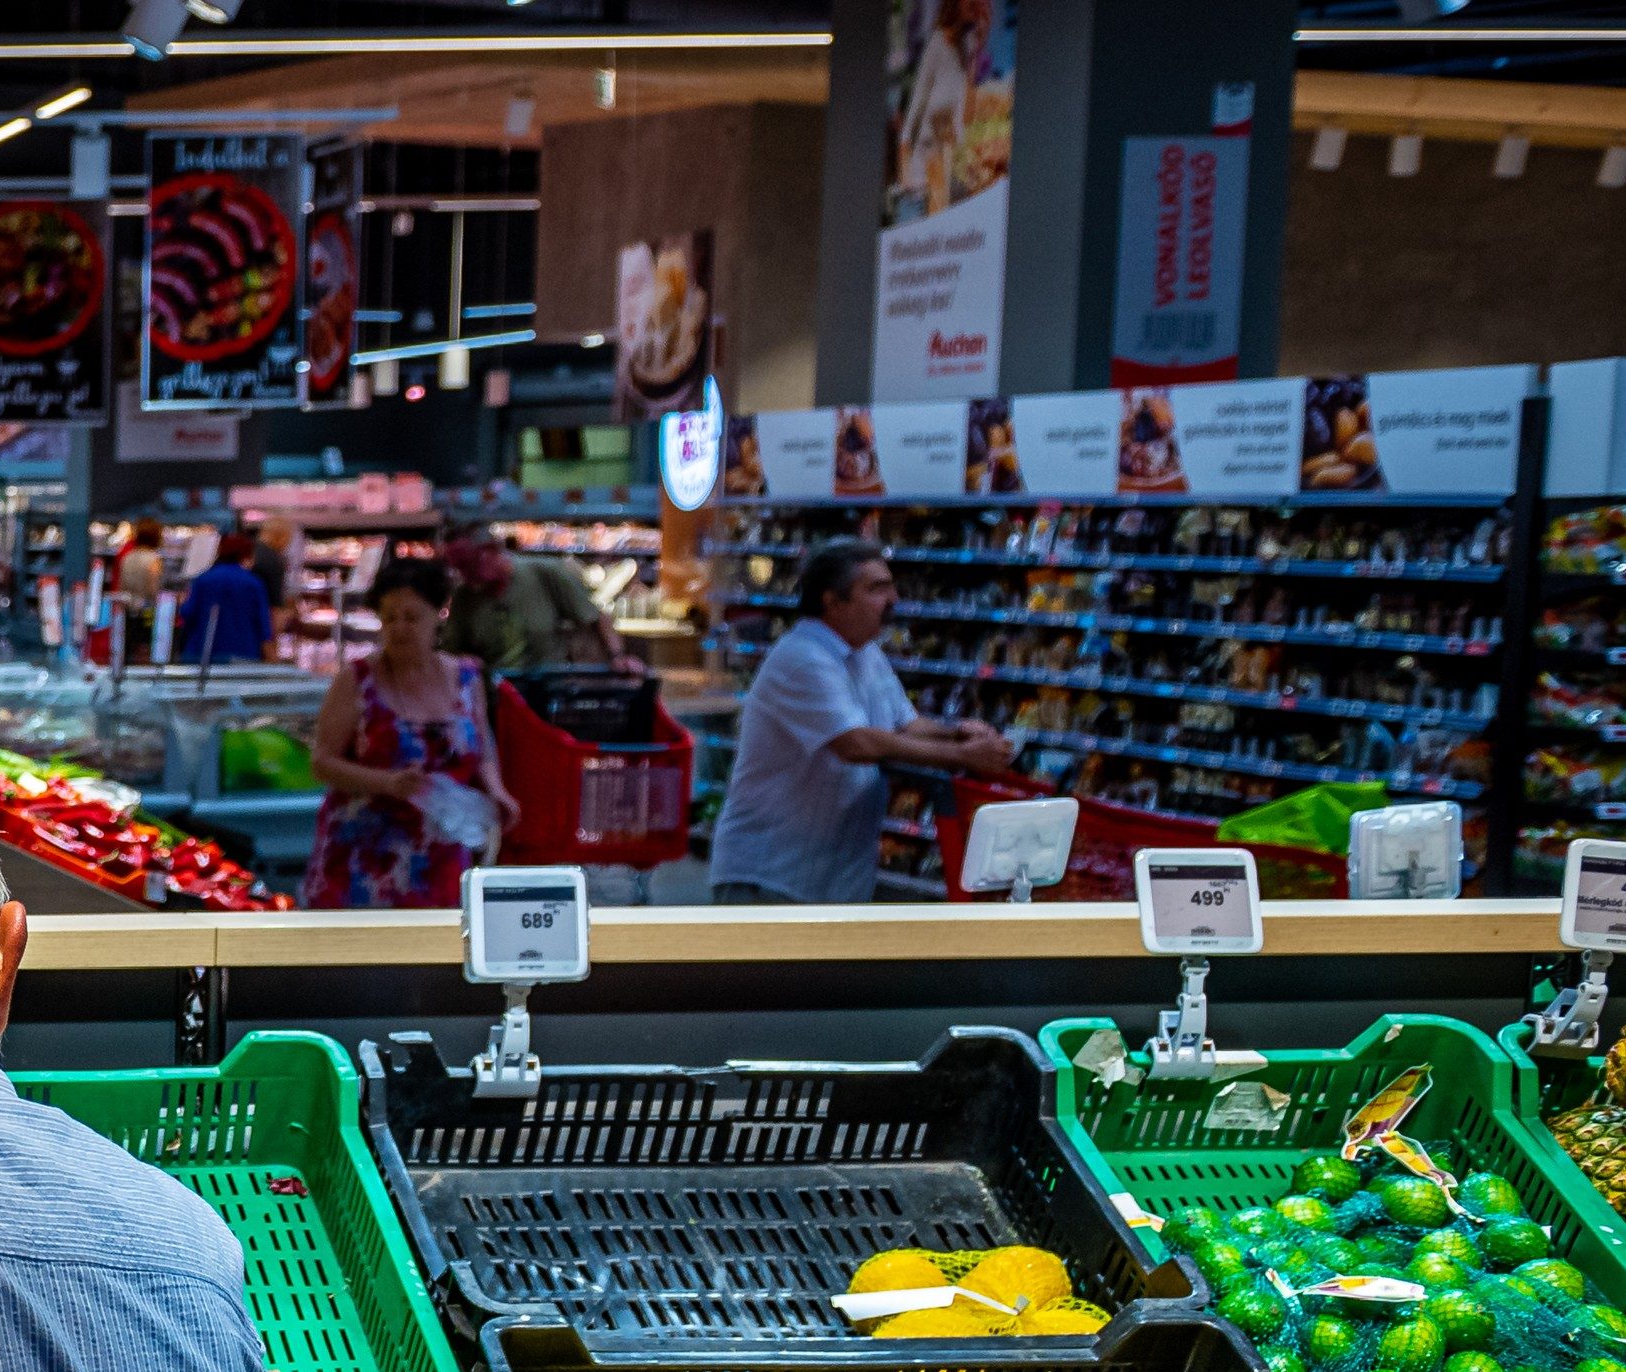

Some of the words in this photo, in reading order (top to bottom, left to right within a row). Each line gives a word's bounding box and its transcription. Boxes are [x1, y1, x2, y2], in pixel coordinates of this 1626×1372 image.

[928, 328, 988, 359] Auchan
[1191, 890, 1224, 906] 499
[521, 912, 554, 929] 689
